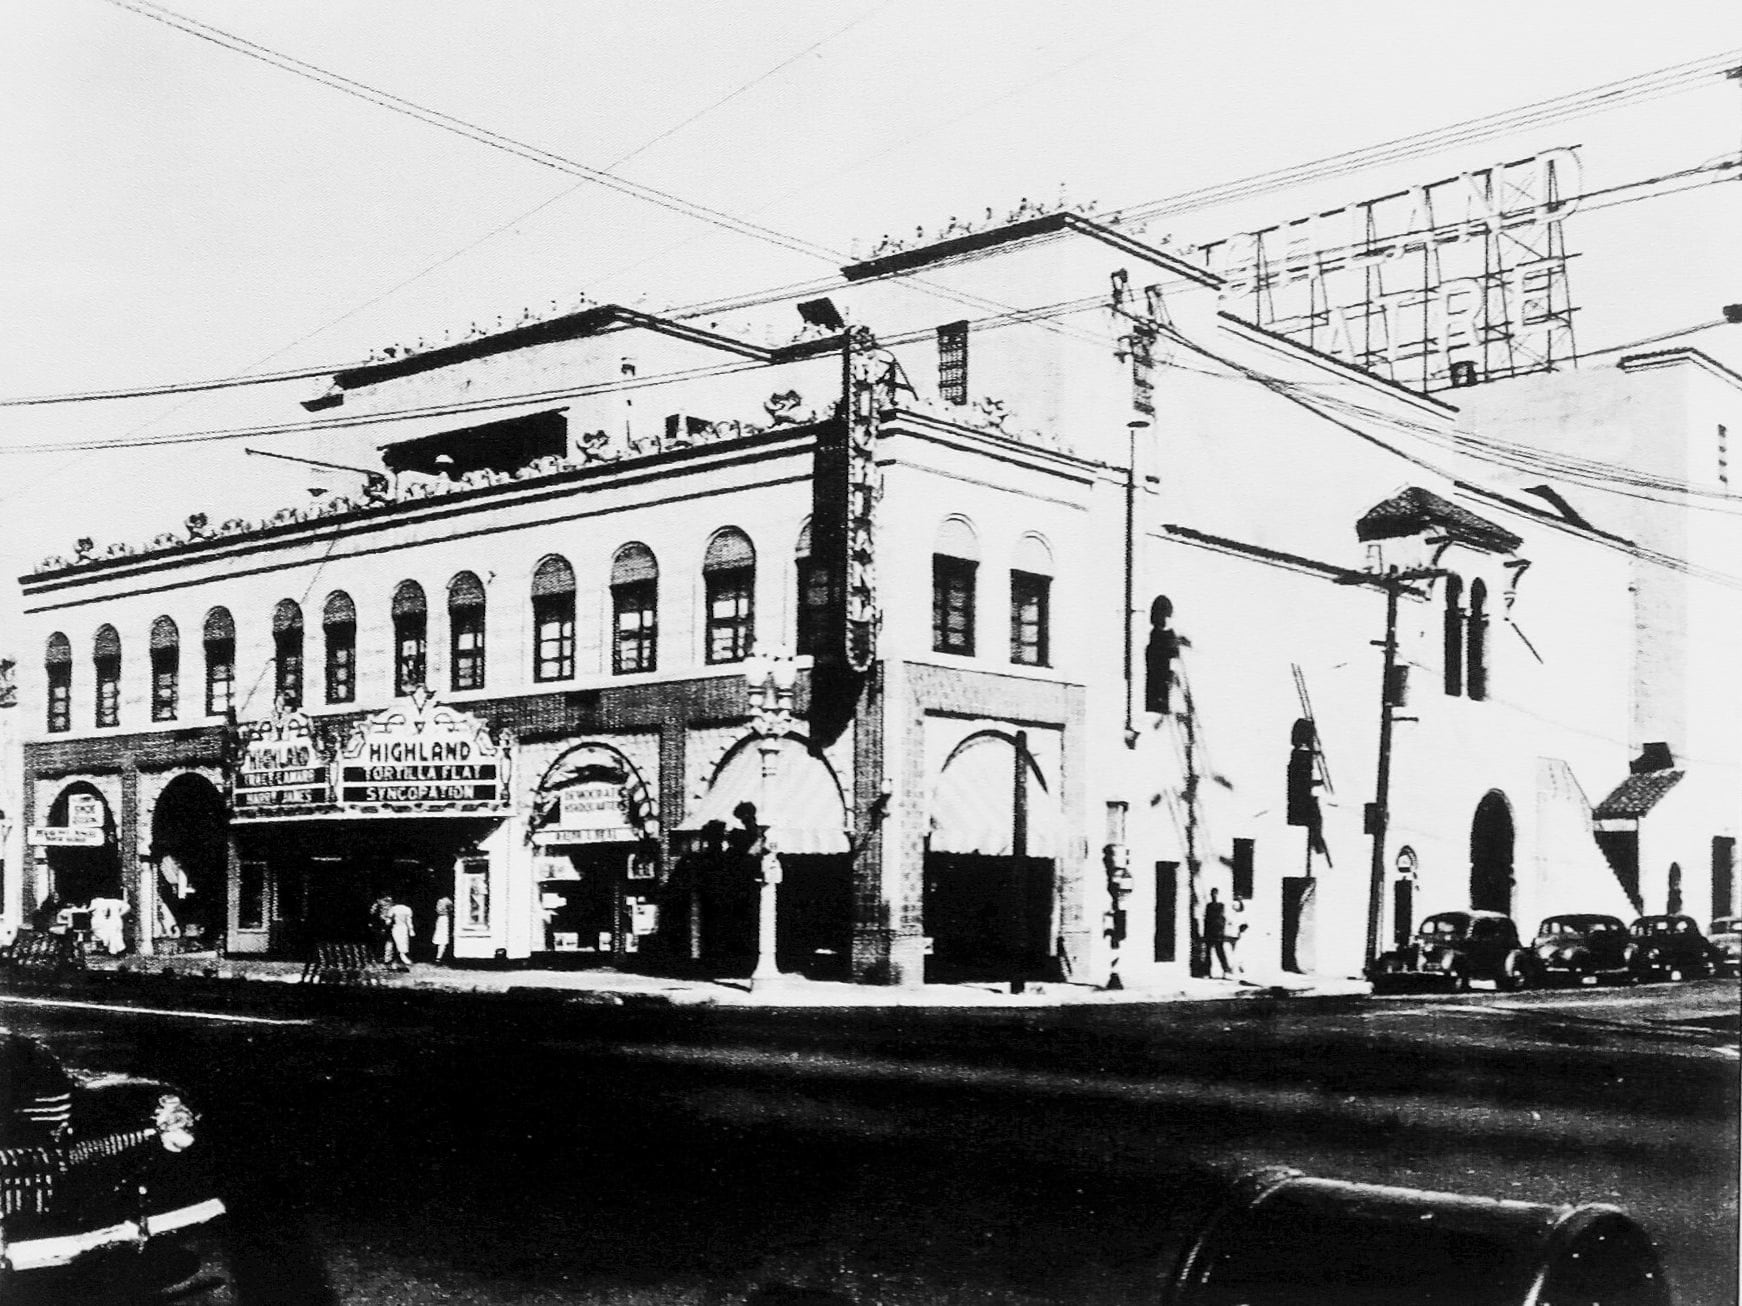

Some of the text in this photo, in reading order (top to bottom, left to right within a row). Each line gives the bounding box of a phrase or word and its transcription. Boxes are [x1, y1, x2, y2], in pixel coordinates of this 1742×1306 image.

[369, 741, 471, 762] HIGHLAND
[362, 763, 481, 780] TORTILLA FLAT
[366, 785, 475, 801] SYNCOPATION
